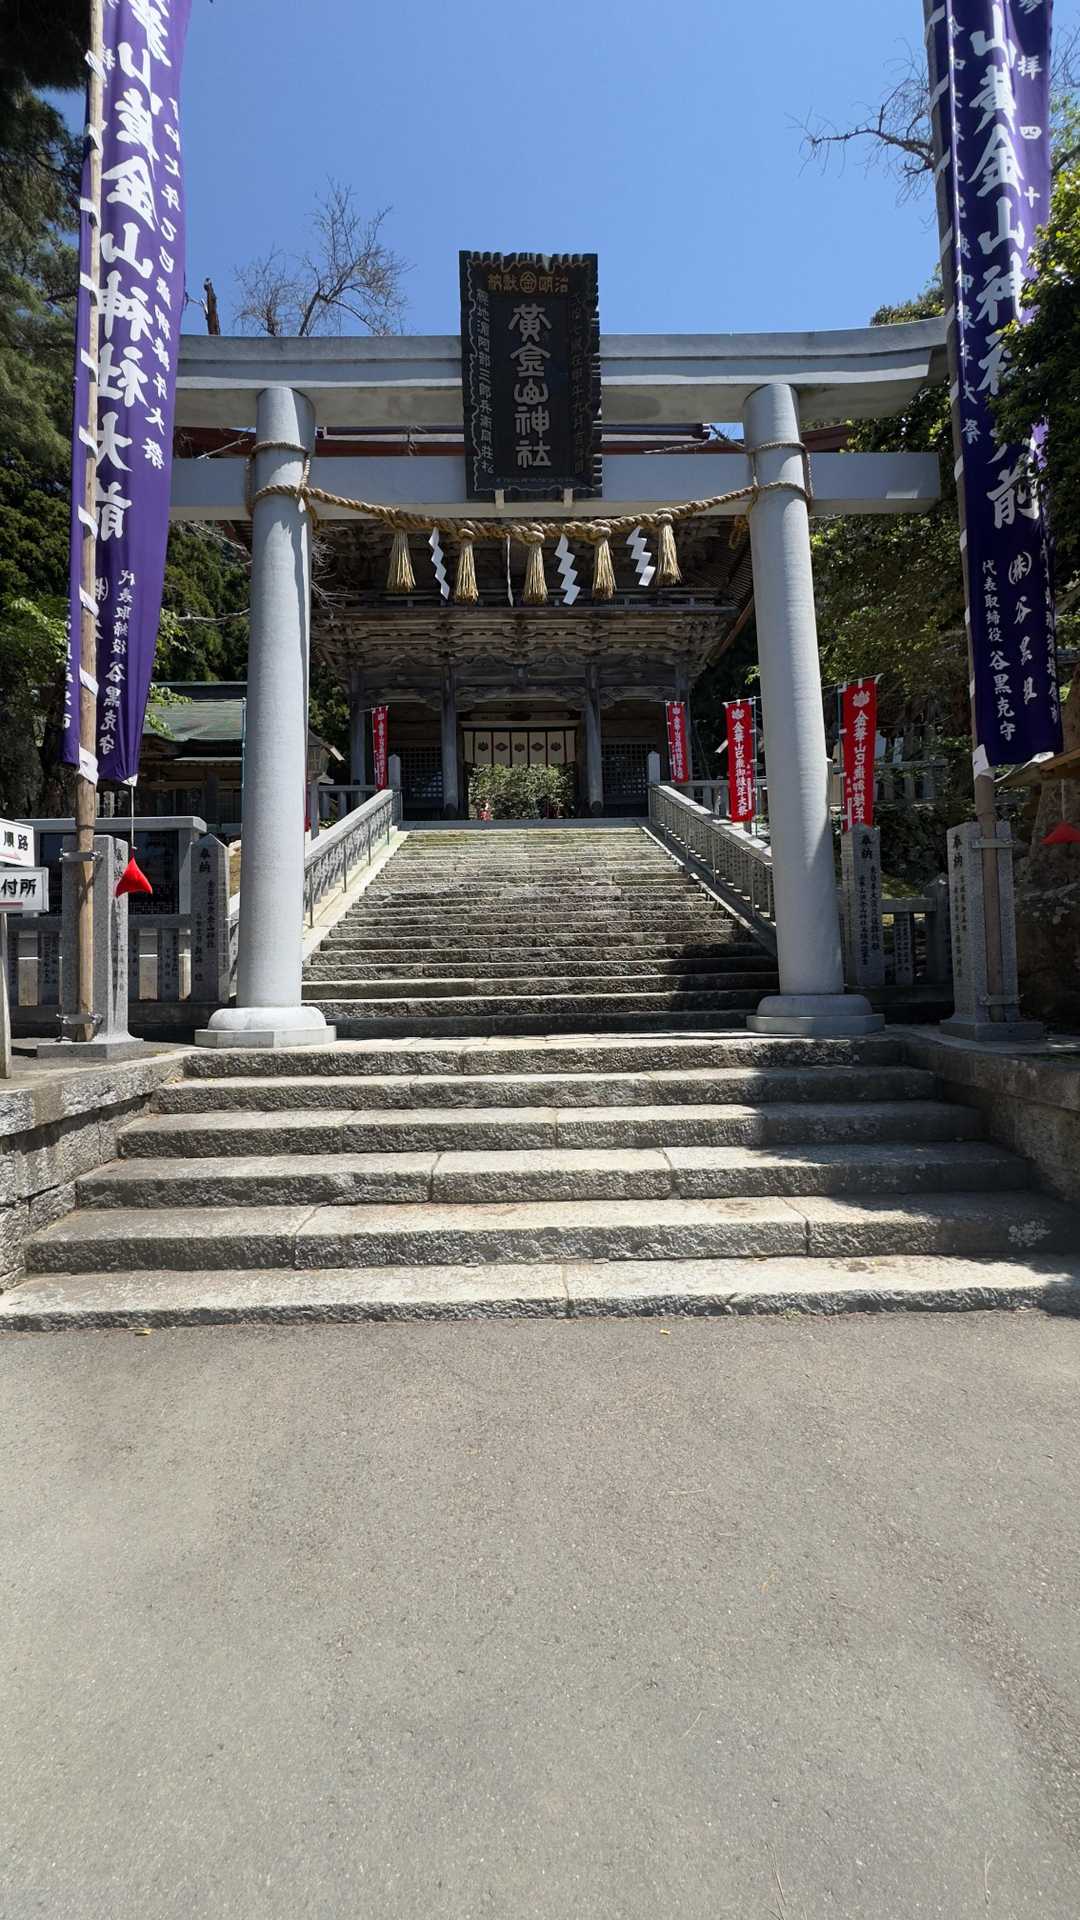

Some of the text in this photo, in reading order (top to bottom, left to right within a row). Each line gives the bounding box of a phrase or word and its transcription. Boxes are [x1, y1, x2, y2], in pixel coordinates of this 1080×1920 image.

[507, 303, 552, 469] 黄金山神社
[4, 830, 28, 851] 順路
